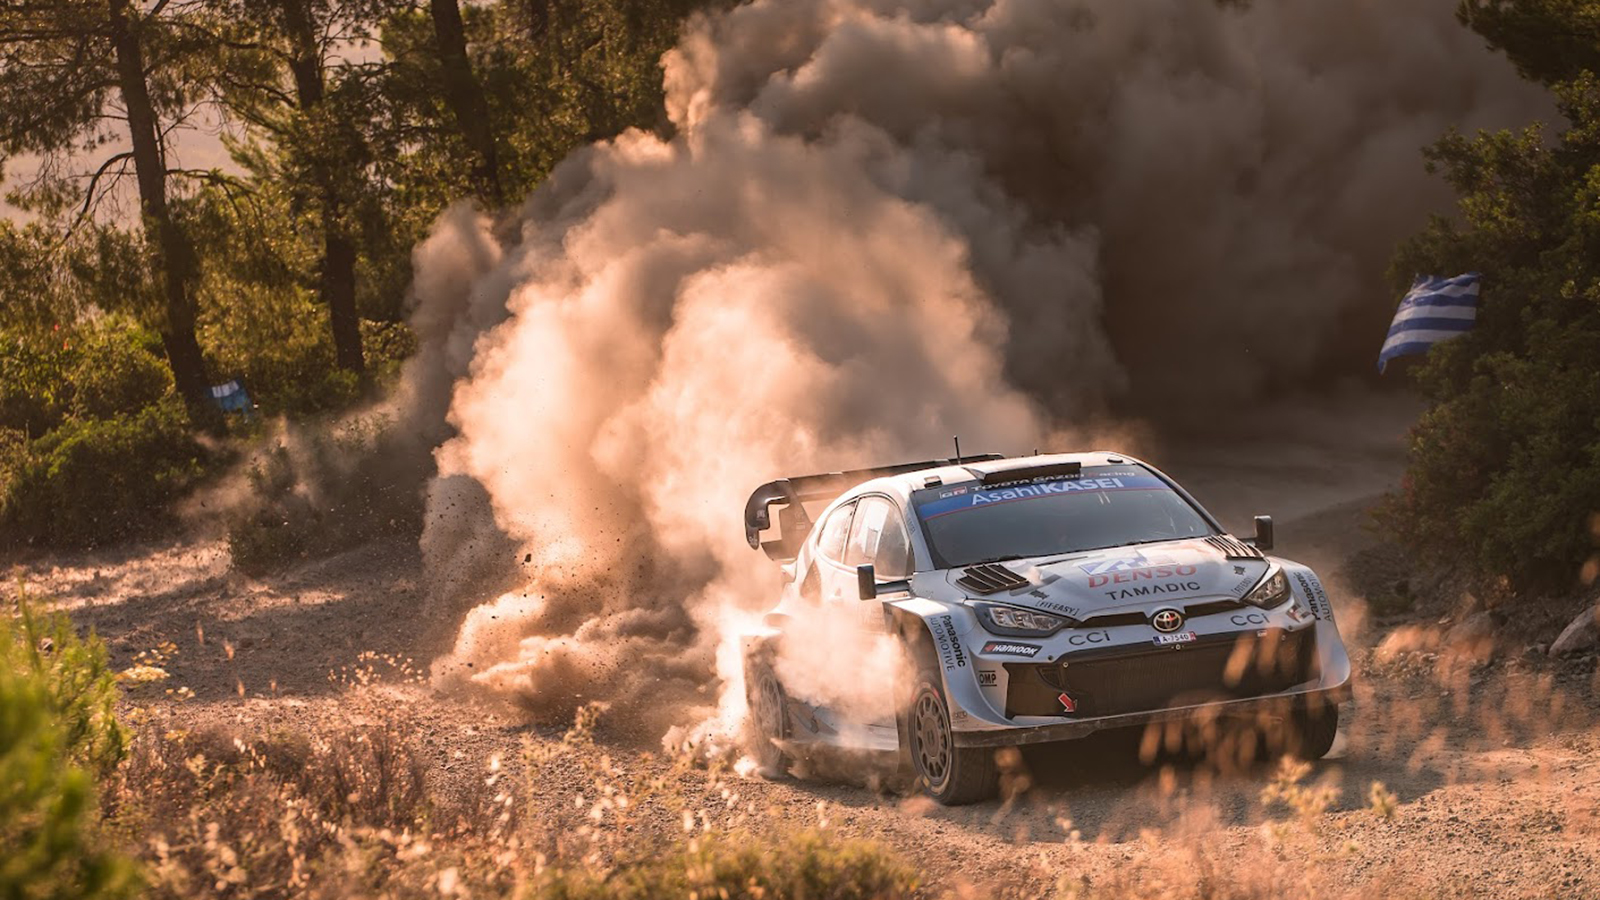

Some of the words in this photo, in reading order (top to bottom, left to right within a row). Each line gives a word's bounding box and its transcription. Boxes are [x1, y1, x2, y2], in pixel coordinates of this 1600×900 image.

[971, 479, 1030, 492] TOYOTA
[972, 477, 1125, 506] AsahiKASEI
[1088, 565, 1197, 589] DENSO
[1105, 582, 1201, 601] TAMADIC
[1293, 571, 1322, 621] Panasonic
[929, 617, 956, 672] AUTOMOTIVE
[940, 614, 967, 668] Panasonic
[979, 673, 997, 684] OMP
